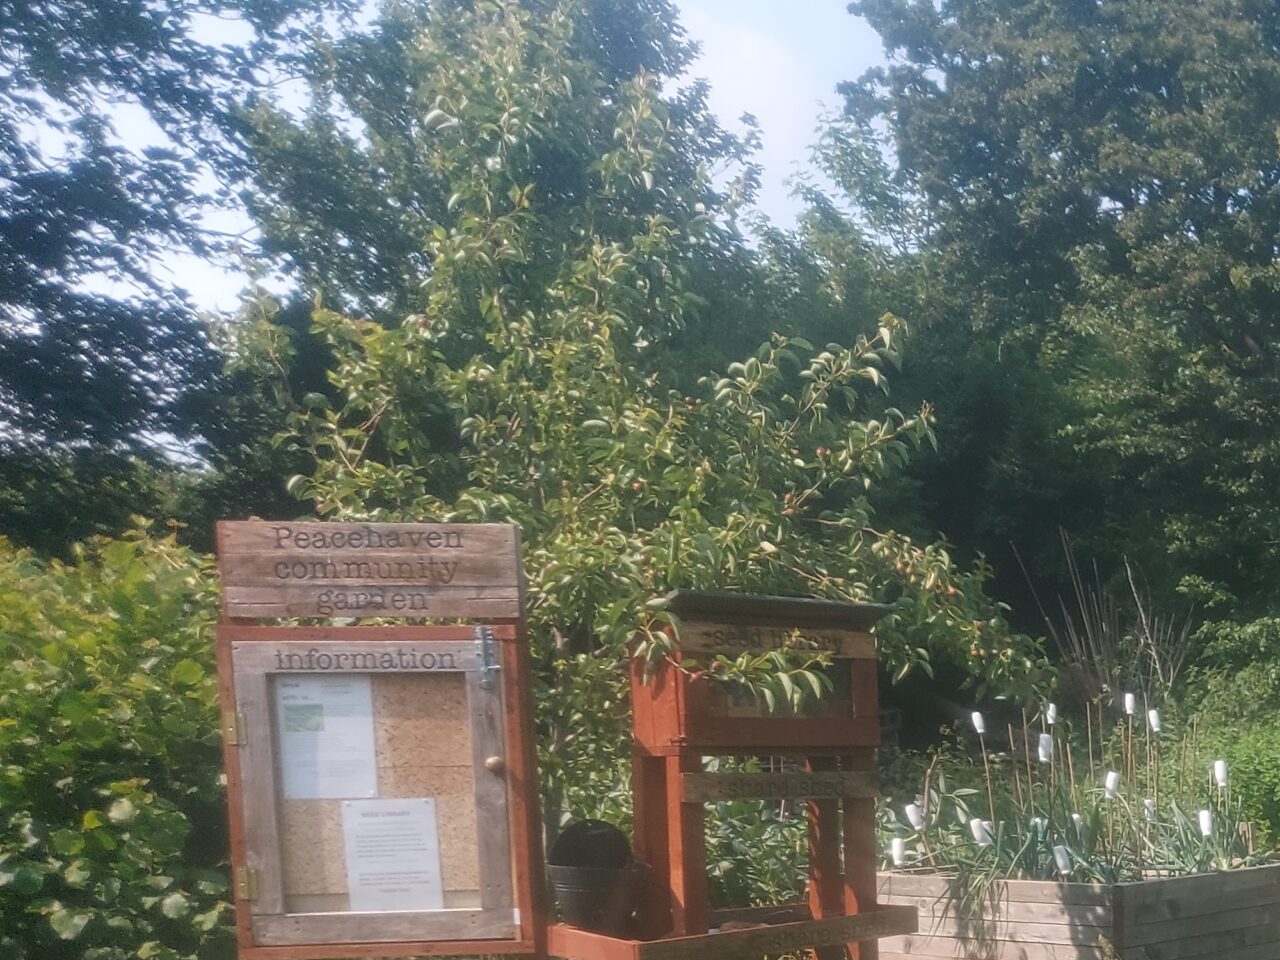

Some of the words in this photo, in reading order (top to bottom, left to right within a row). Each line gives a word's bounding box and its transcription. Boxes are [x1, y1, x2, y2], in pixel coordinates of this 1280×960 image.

[271, 525, 465, 550] Peacehaven
[273, 557, 459, 585] community
[316, 588, 429, 615] garden
[714, 628, 762, 648] seed
[274, 649, 458, 671] information
[728, 777, 789, 798] share
[772, 925, 833, 950] share
